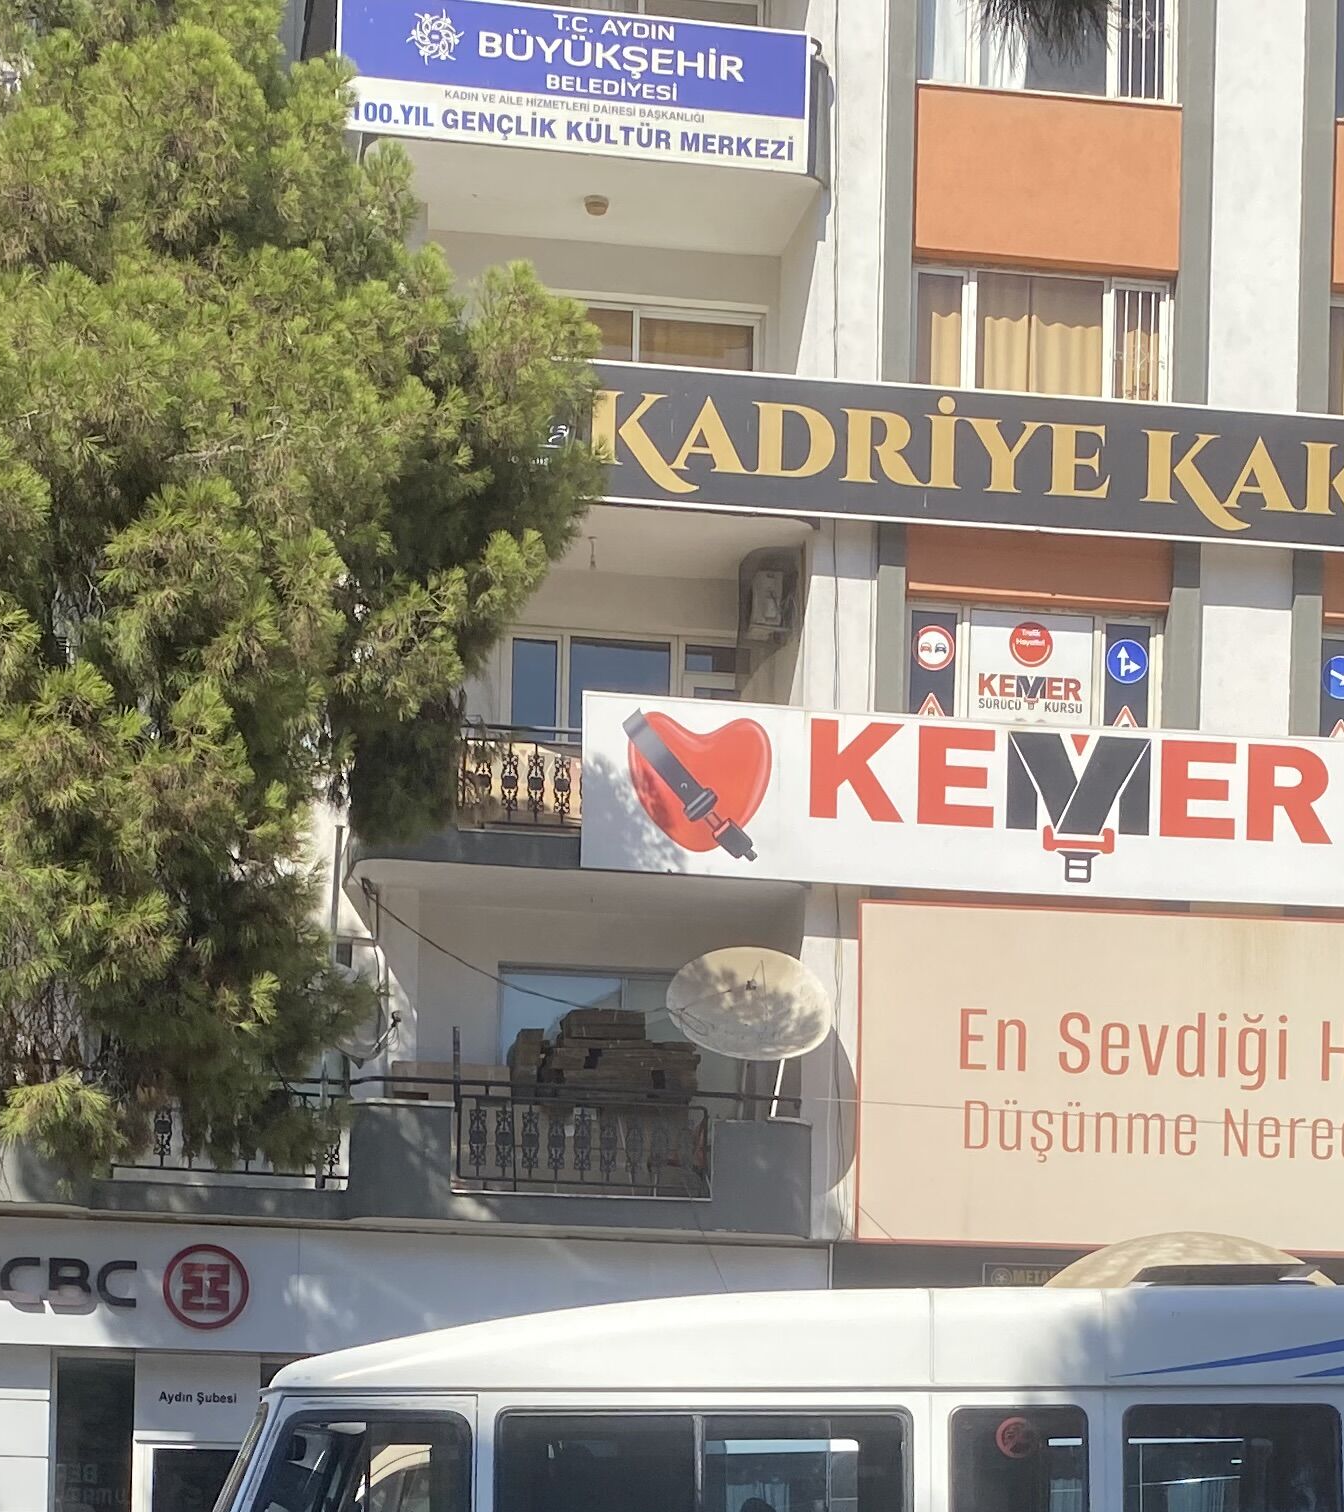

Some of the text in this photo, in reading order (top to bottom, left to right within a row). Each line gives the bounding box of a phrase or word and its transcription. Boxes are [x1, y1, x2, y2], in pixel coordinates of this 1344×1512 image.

[553, 14, 675, 42] T.C. AYDIN
[478, 29, 745, 83] BÜYÜKŞEHİR
[444, 89, 705, 124] KADIN VE AİLE HİZMETLERİ DAİRESİ BAŞKANLIĞI
[546, 74, 678, 102] BELEDİYESİ
[354, 101, 795, 162] 100.YIL GENÇLİK KÜLTÜR MERKEZİ
[589, 388, 1110, 499] KADRİYE
[978, 672, 1083, 702] KEMER
[978, 697, 1084, 714] SÜRÜCÜ KURSU
[808, 718, 1334, 846] KEMER
[958, 1006, 1029, 1072] En
[1057, 1010, 1289, 1091] Sevdiği
[962, 1099, 1198, 1164] Düşünme
[158, 1390, 238, 1407] Aydın Şubesi
